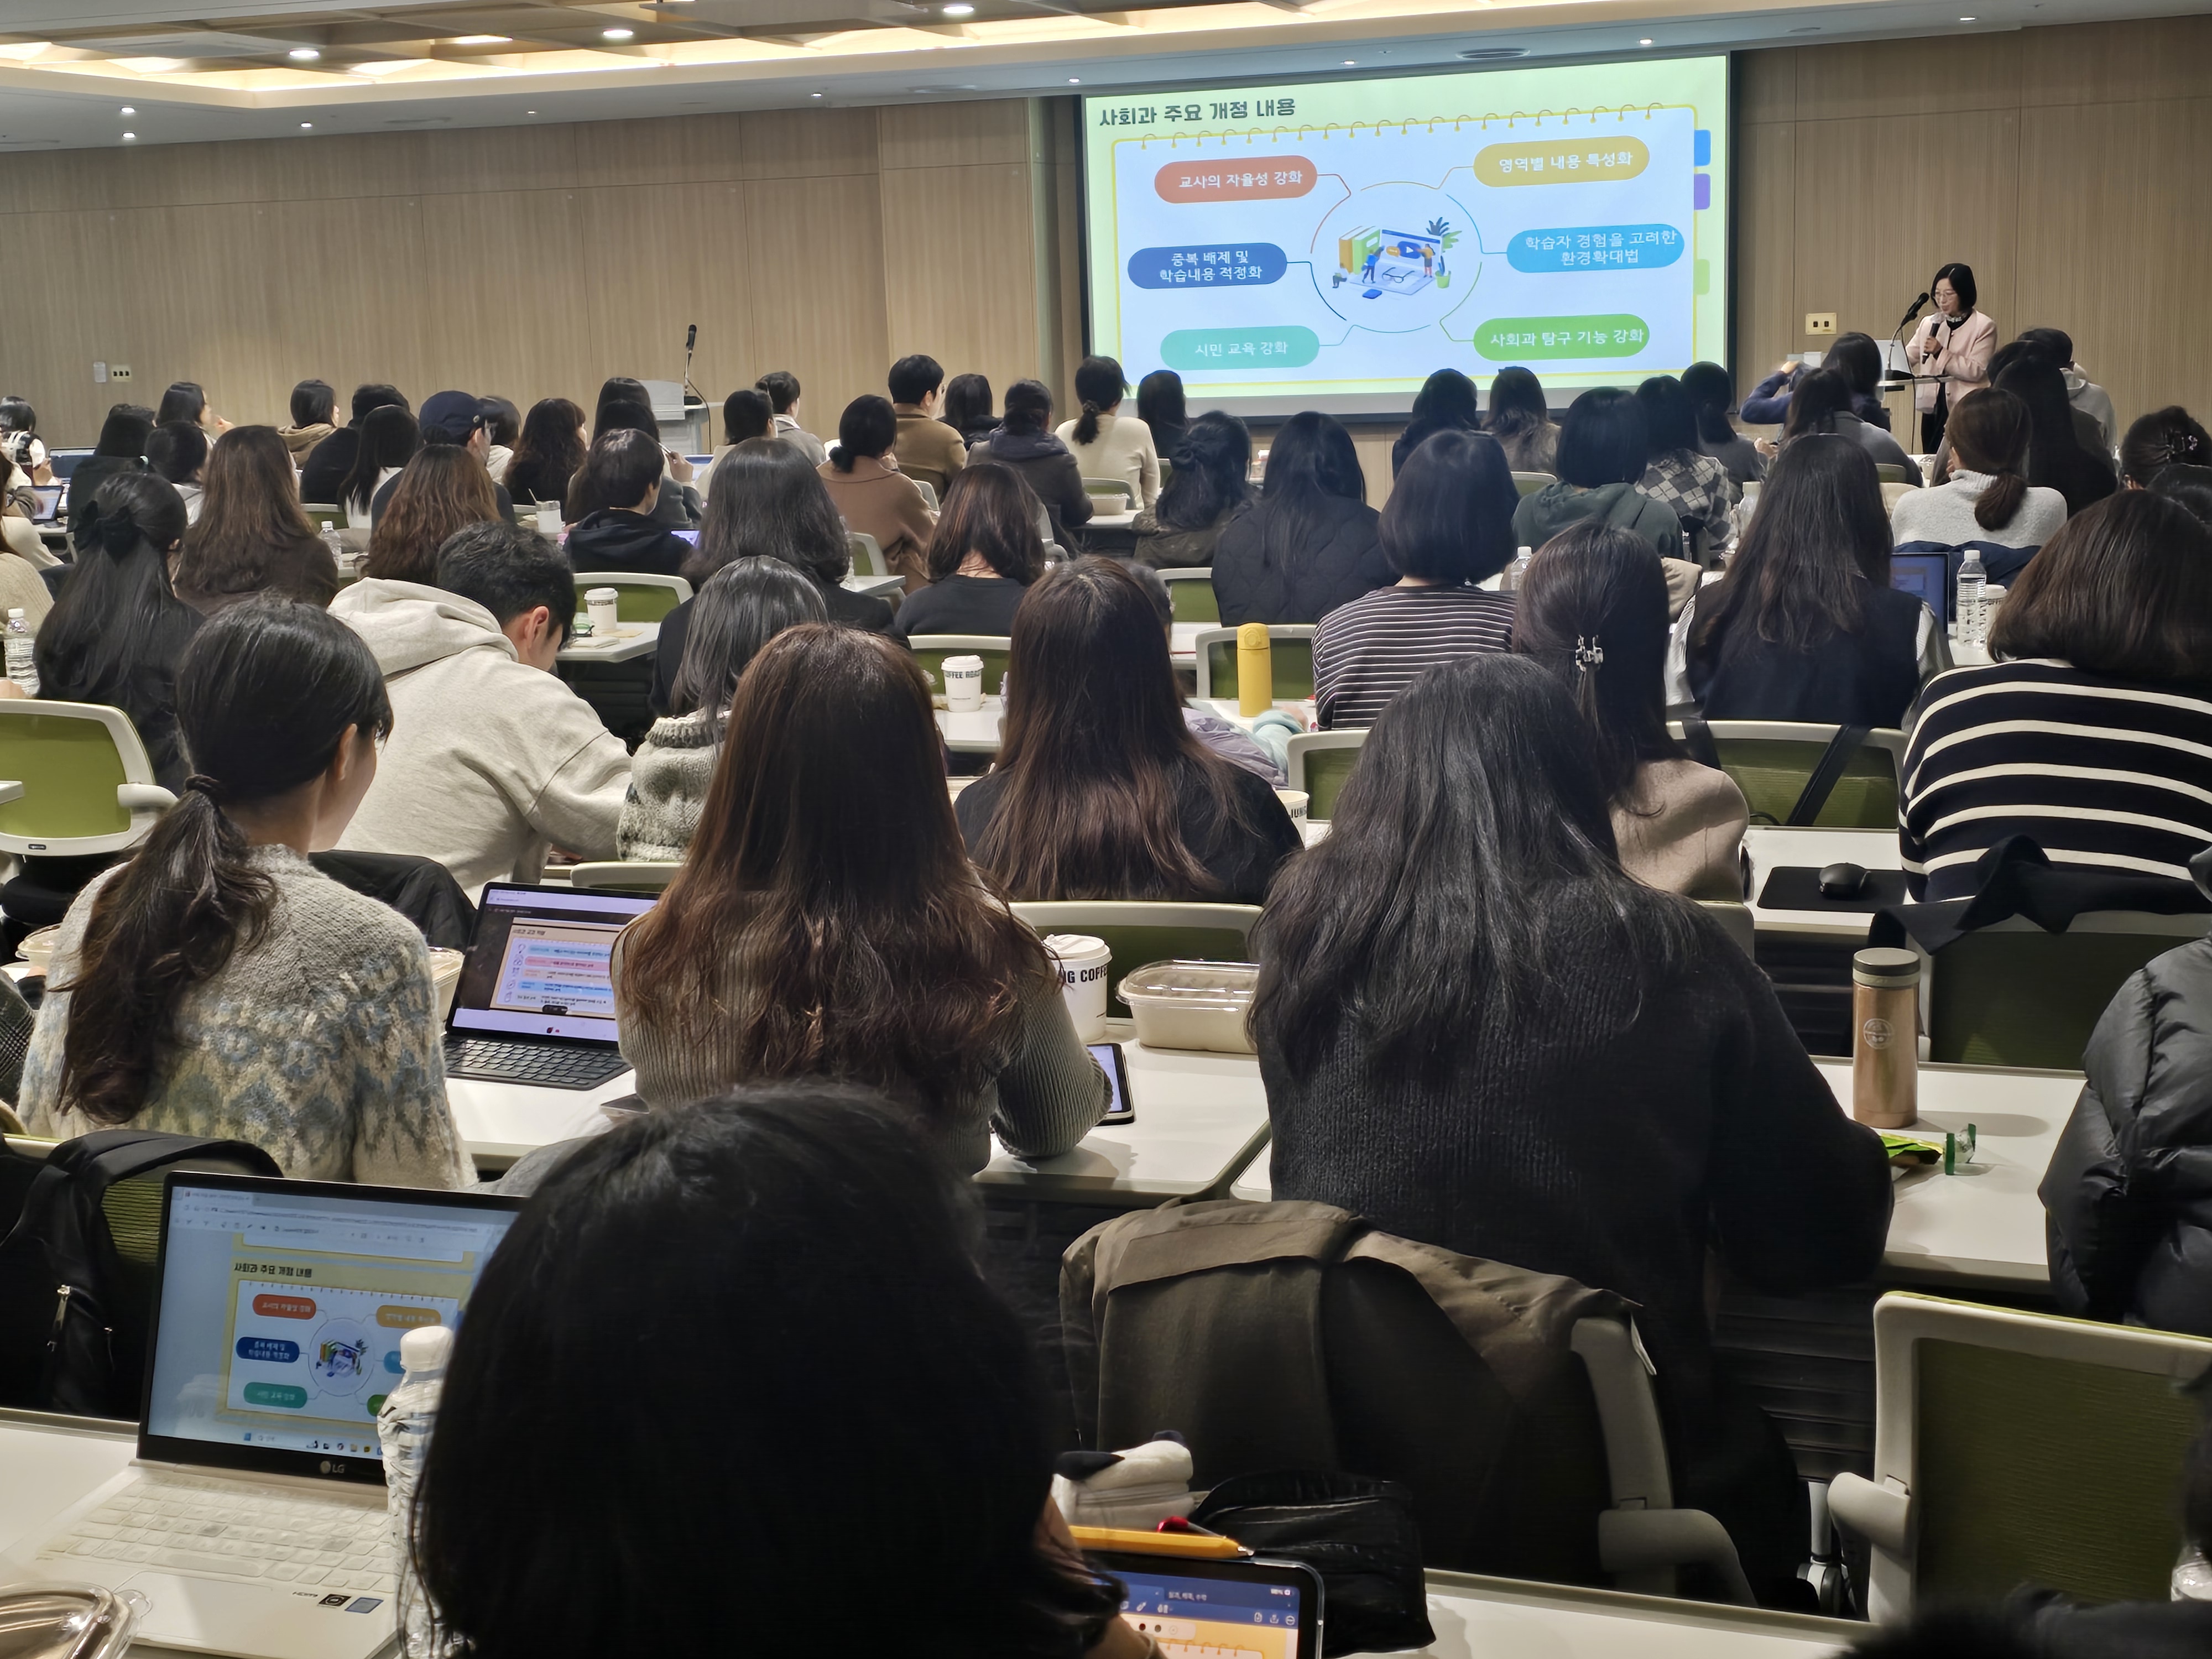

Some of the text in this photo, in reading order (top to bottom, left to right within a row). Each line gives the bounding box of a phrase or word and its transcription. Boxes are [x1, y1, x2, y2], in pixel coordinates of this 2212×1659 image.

[1099, 98, 1296, 126] 사회과 주요 개정 내용
[1499, 152, 1634, 173] 영역별 내용 특성화
[1178, 170, 1302, 189] 교사의 자율성 강화
[1525, 229, 1677, 251] 학습자 경험을 고려한
[1171, 250, 1249, 267] 중복 배제 및
[1561, 249, 1639, 265] 환경확대법
[1160, 265, 1262, 283] 학습내용 적정화
[1490, 328, 1644, 347] 사회과 탐구 기능 강화
[1195, 341, 1288, 357] 시민 교육 강화
[332, 1464, 345, 1474] LG
